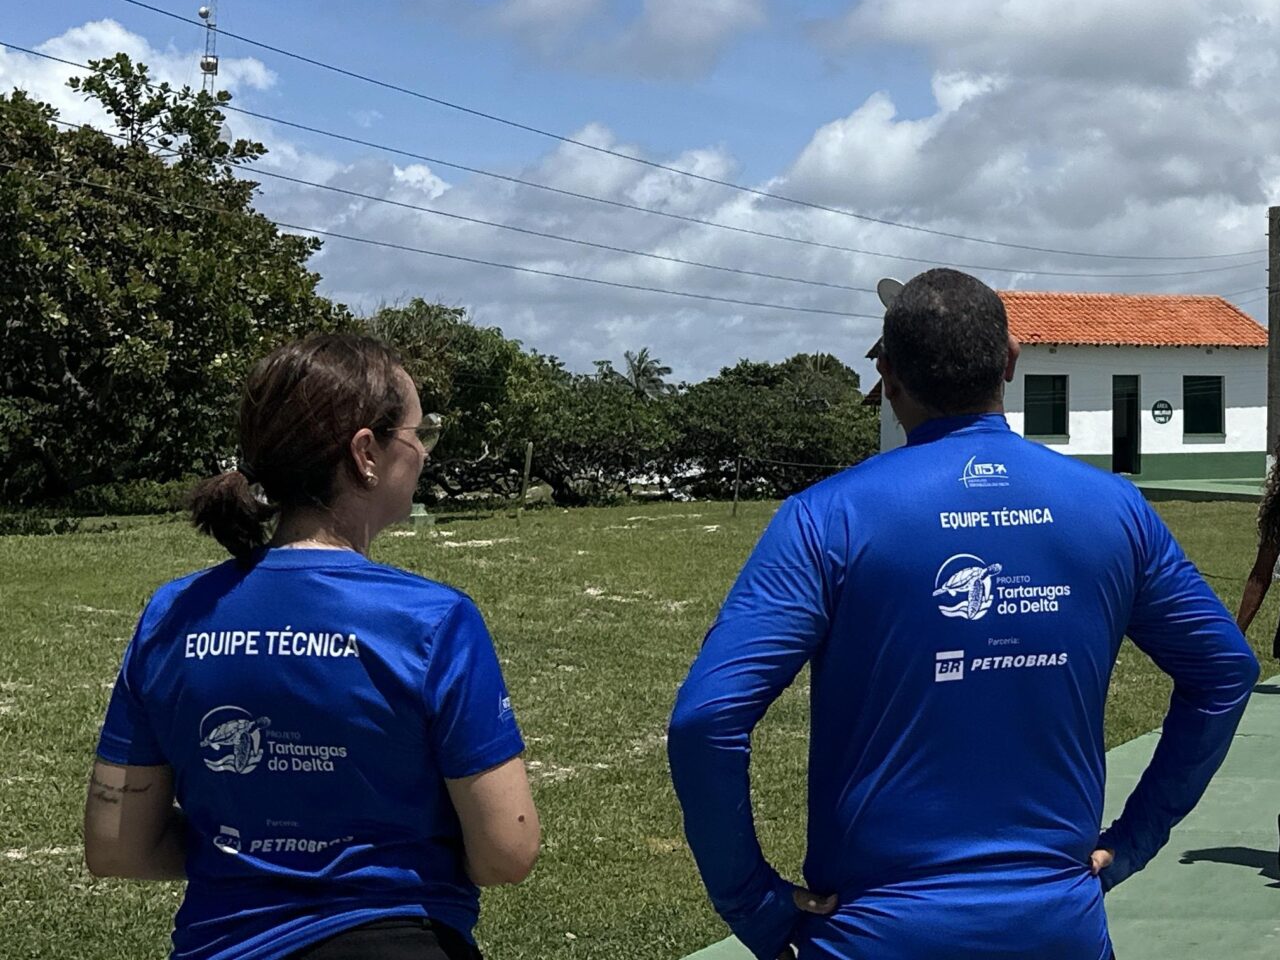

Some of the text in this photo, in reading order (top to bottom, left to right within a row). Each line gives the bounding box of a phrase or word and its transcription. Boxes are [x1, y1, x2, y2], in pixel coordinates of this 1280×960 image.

[939, 506, 1054, 530] EQUIPE TÉCNICA
[996, 575, 1031, 584] PROJETO
[996, 585, 1071, 600] Tartarugas
[997, 598, 1059, 614] do Delta
[184, 624, 360, 660] EQUIPE TÉCNICA
[970, 652, 1068, 672] PETROBRAS
[267, 741, 347, 760] Tartarugas
[268, 757, 334, 771] do Delta
